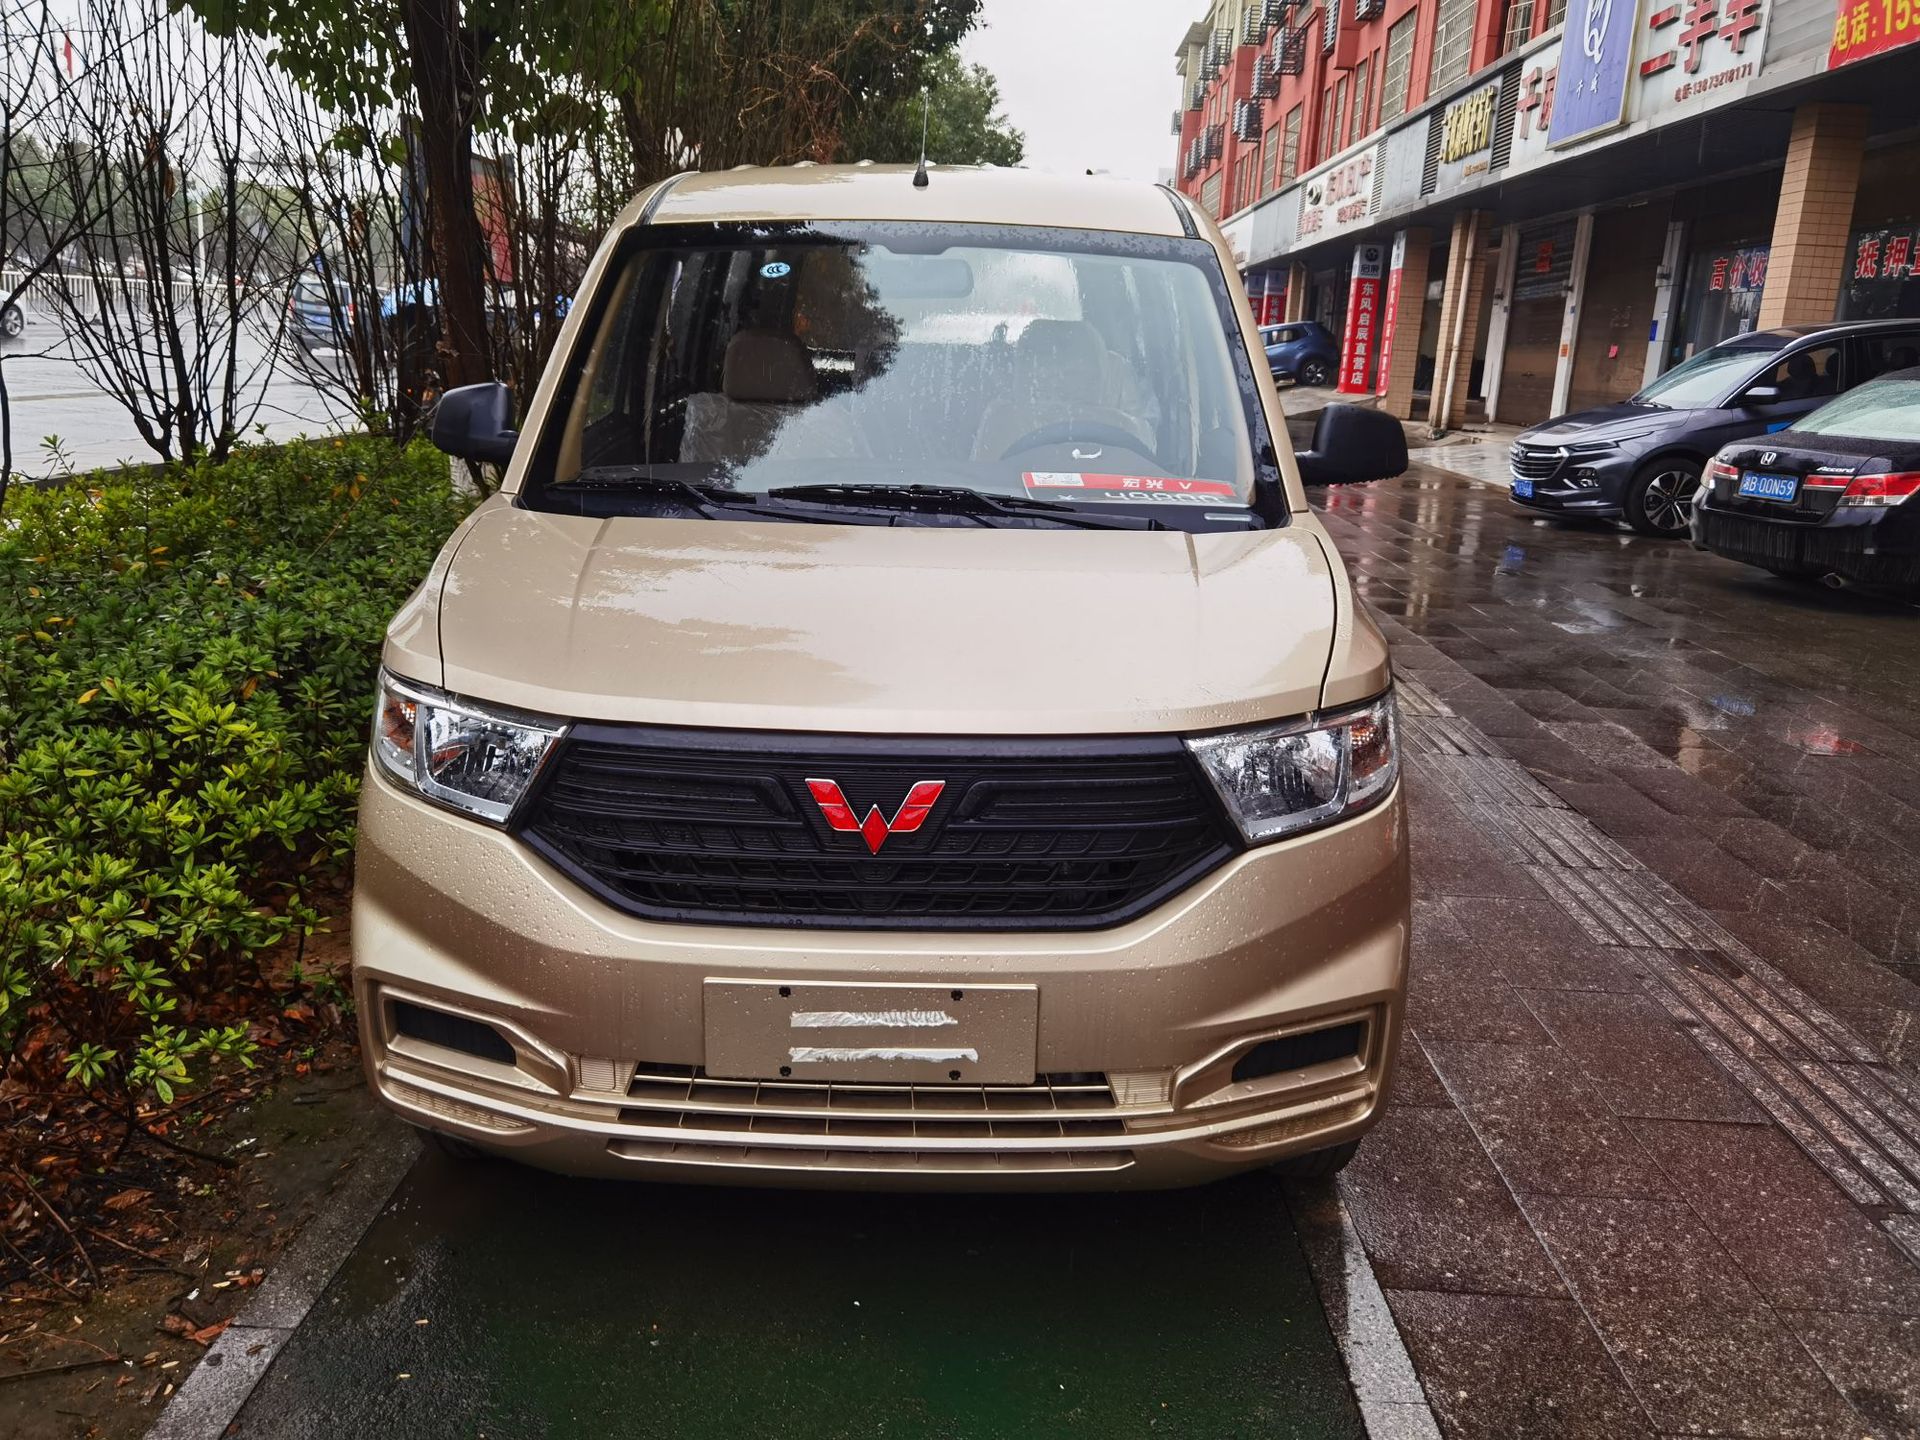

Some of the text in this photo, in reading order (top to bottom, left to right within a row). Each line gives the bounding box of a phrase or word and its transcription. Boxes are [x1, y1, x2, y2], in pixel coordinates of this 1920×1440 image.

[1709, 251, 1768, 291] 高价收
[1350, 281, 1375, 385] 东风启辰直营店
[1122, 478, 1192, 490] 宏光 V
